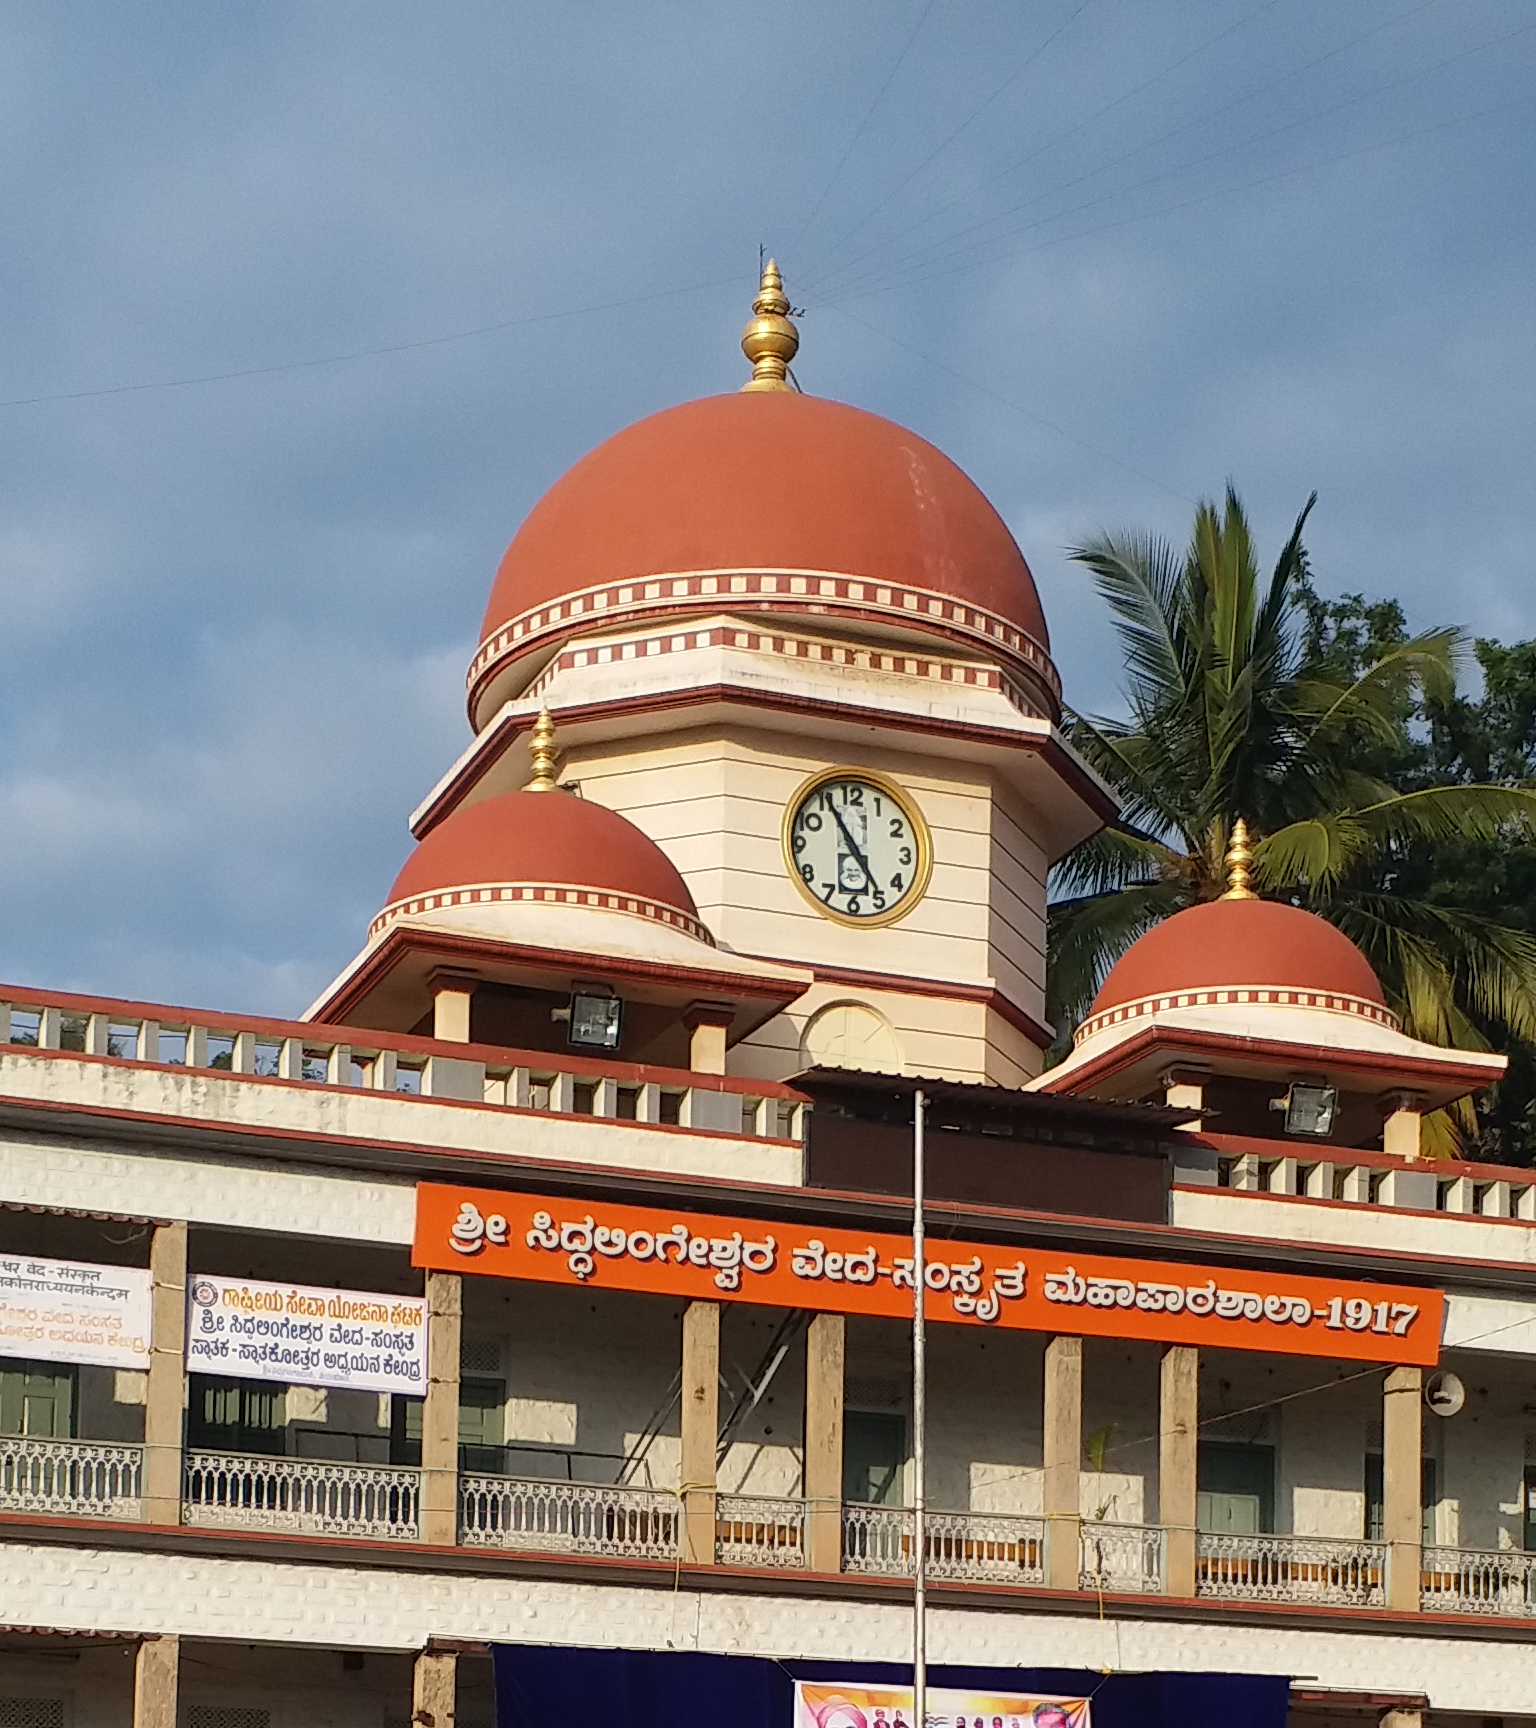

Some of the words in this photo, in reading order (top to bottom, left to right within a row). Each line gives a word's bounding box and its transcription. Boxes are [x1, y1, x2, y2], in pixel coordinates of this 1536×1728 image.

[841, 786, 863, 807] 12
[874, 797, 881, 817] 1
[799, 811, 823, 832] 10
[890, 819, 904, 838] 2
[794, 835, 807, 854] 9
[899, 846, 911, 865] 3
[801, 864, 814, 883] 8
[890, 873, 903, 892] 4
[822, 883, 835, 903] 7
[872, 890, 886, 909] 5
[847, 895, 860, 913] 6
[448, 1201, 509, 1255] ಶ್ರೀ
[286, 1290, 325, 1317] ಸೇವಾ
[328, 1295, 389, 1322] ಯೋಜನಾ
[199, 1309, 225, 1334] ಶ್ರೀ
[382, 1353, 422, 1382] ಕೇಂದ್ರ
